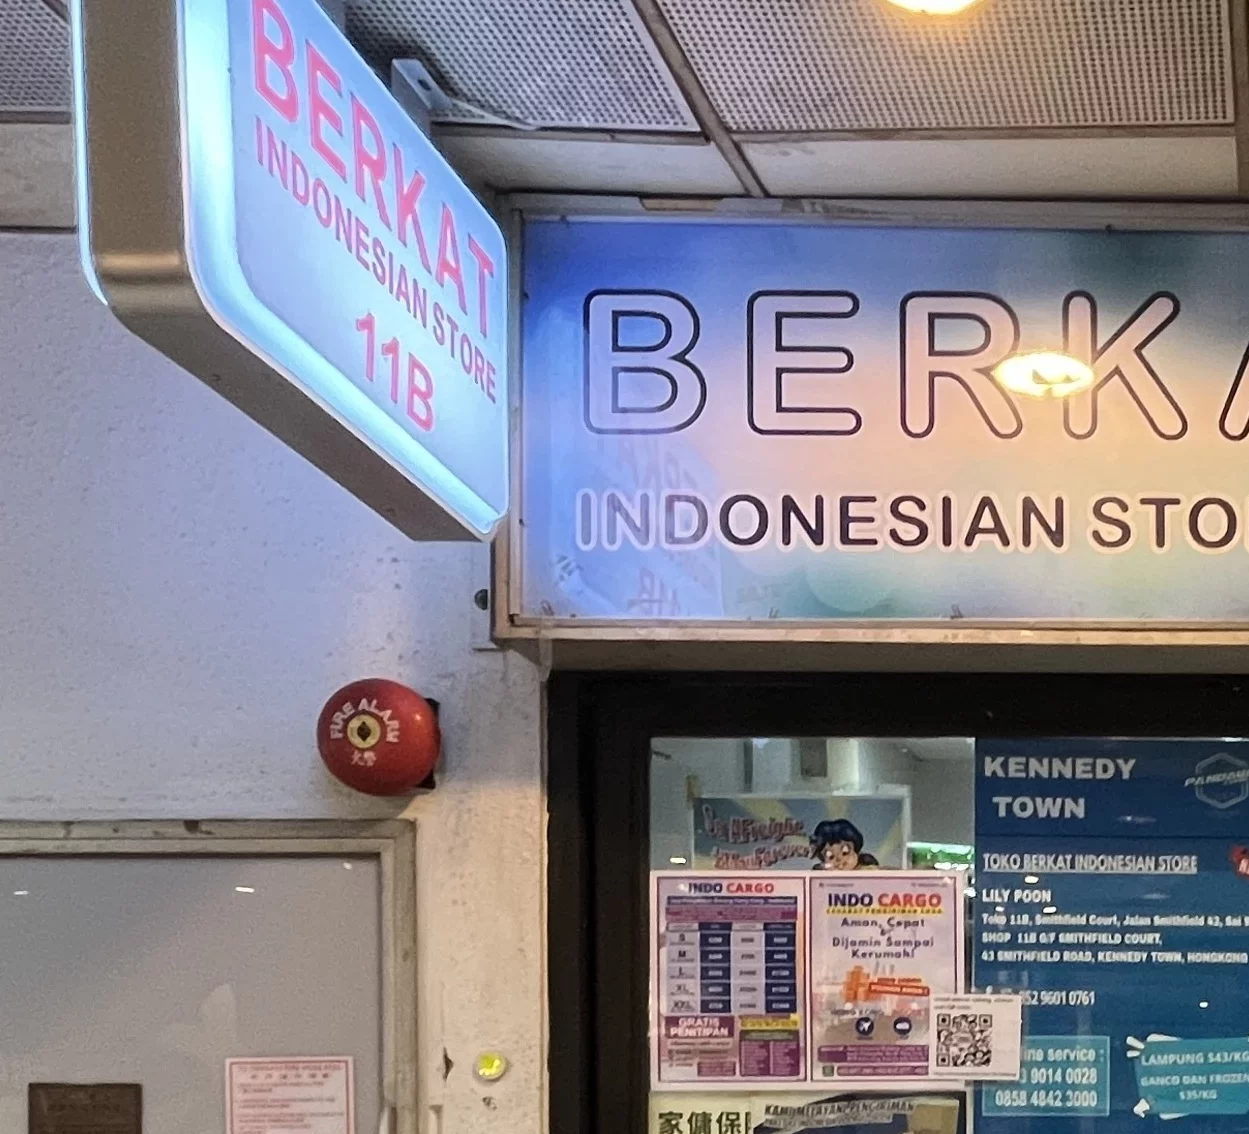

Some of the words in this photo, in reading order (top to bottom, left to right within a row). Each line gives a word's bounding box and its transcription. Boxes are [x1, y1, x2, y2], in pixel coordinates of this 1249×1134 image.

[252, 0, 495, 338] BERKAT
[256, 115, 429, 330] INDONESIAN
[432, 300, 498, 404] STORE
[354, 311, 435, 432] 11B
[581, 493, 1063, 550] INDONESIAN
[329, 701, 356, 740] FIRE
[357, 697, 401, 743] ALARM
[984, 756, 1136, 780] KENNEDY
[992, 796, 1085, 819] TOWN
[983, 854, 1020, 871] TOKO
[1023, 855, 1073, 872] BERKAT
[1075, 856, 1157, 873] INDONESIAN
[1158, 856, 1198, 873] STORE
[726, 882, 775, 894] CARGO
[982, 889, 1009, 903] LILY
[1014, 889, 1052, 903] POON
[828, 893, 873, 907] INDO
[878, 893, 942, 907] CARGO
[841, 917, 883, 929] Aman,
[887, 917, 926, 929] Cepat
[833, 937, 882, 950] Dijamin
[886, 937, 934, 950] Sampai
[1047, 1045, 1096, 1062] service
[1141, 1052, 1204, 1066] LAMPUNG
